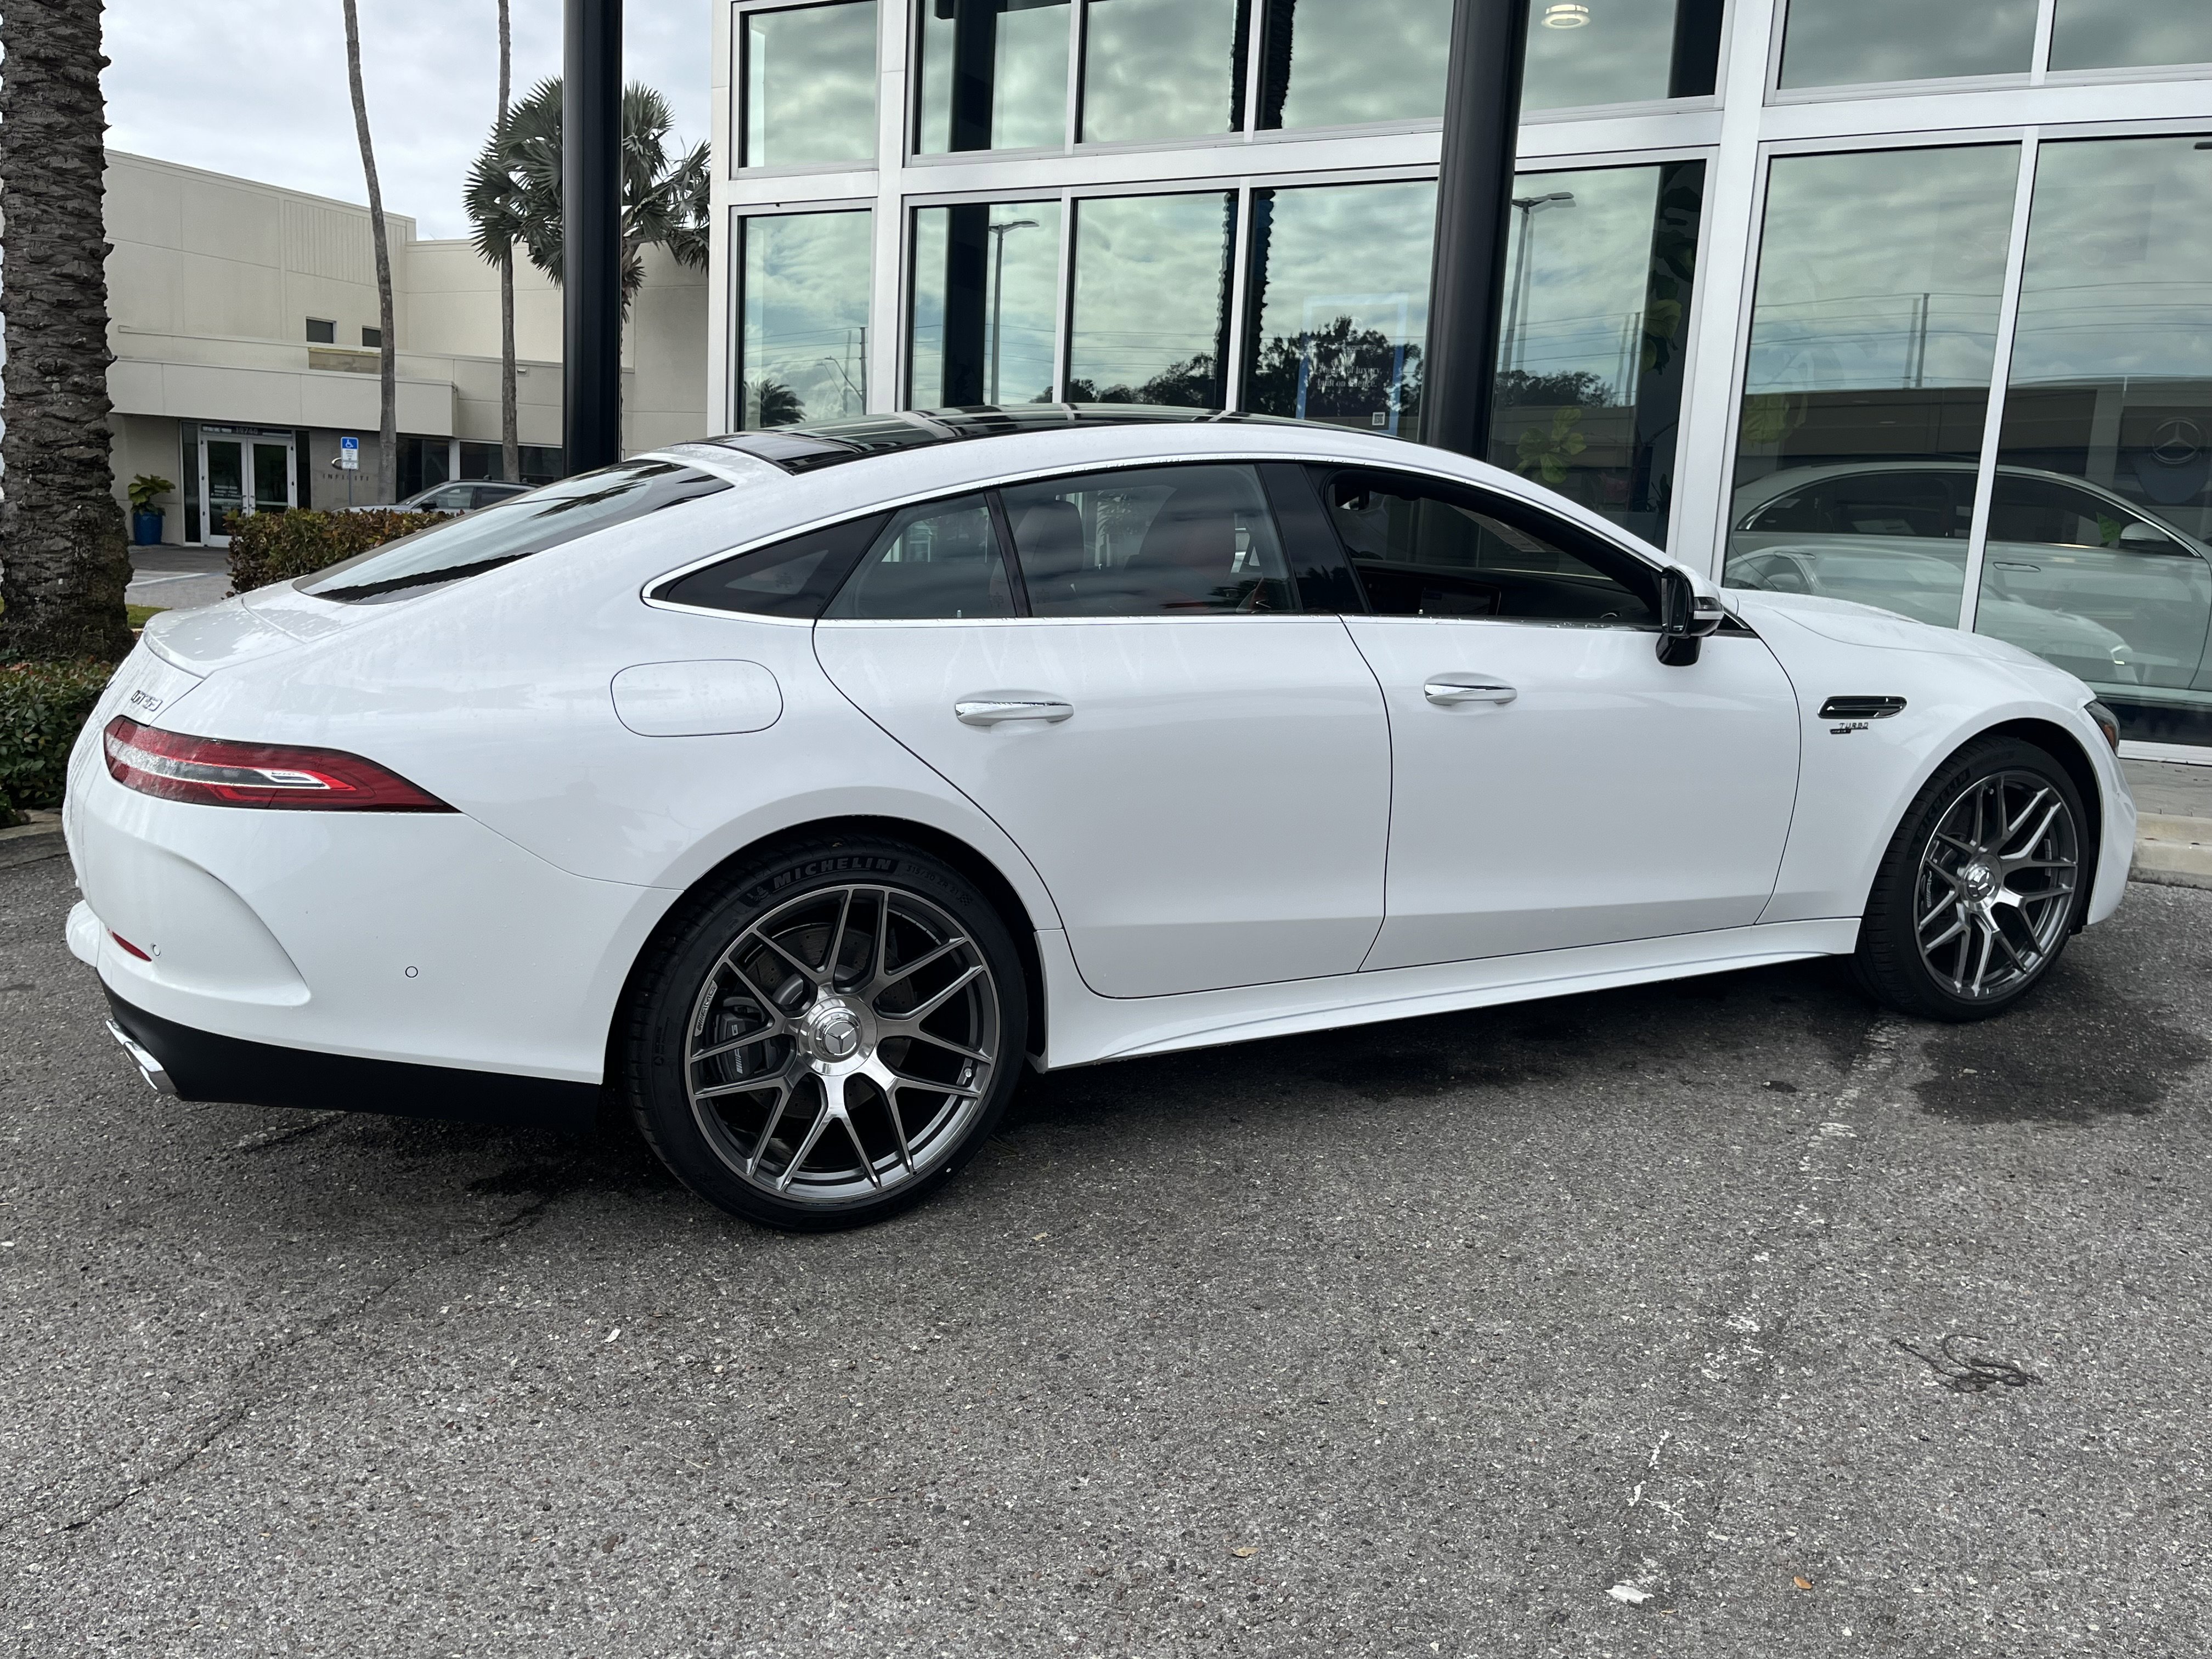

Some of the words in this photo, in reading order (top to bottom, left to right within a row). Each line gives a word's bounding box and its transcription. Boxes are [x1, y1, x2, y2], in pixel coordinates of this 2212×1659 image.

[1346, 366, 1355, 374] of
[773, 857, 892, 889] MICHELIN
[906, 865, 935, 881] 315/30
[938, 879, 949, 888] ZR
[950, 887, 959, 895] 21
